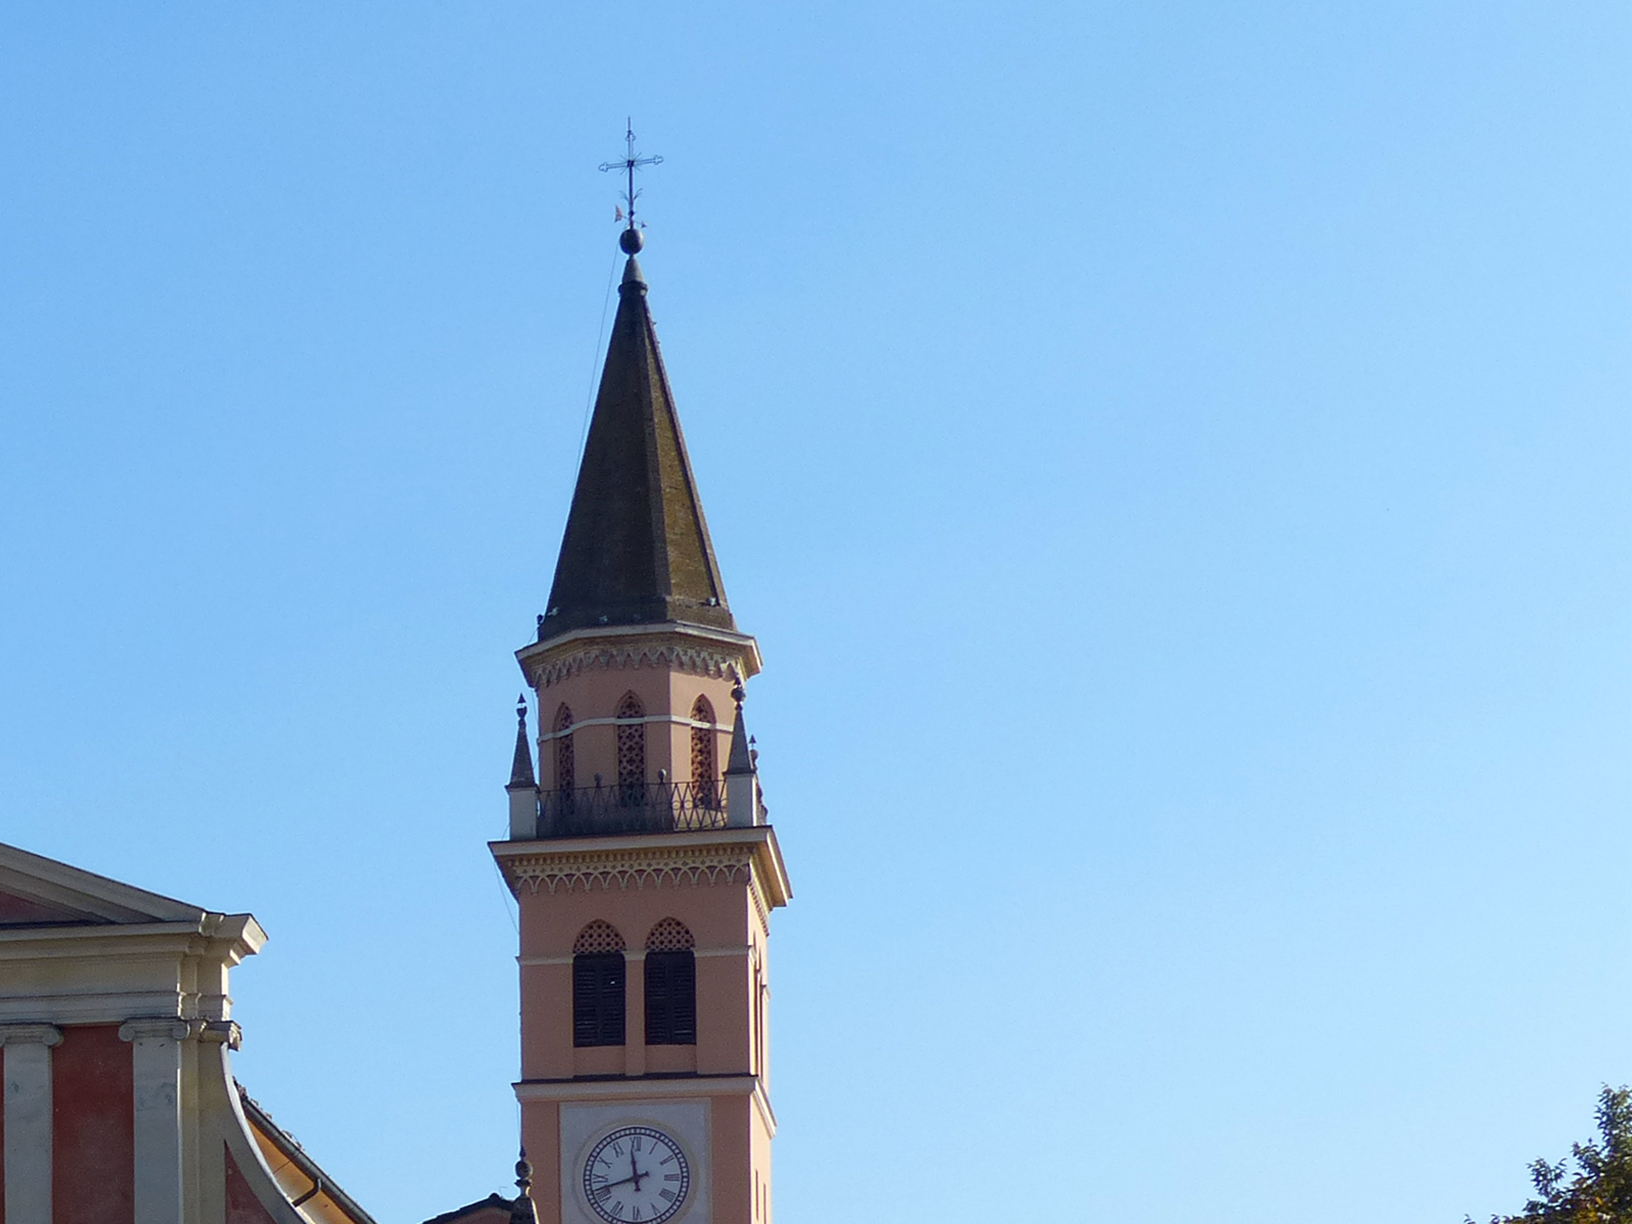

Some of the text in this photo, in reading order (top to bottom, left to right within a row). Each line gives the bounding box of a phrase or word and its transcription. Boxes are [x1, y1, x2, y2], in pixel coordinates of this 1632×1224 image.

[610, 1141, 624, 1158] XI
[649, 1141, 658, 1155] I
[597, 1156, 613, 1169] X
[659, 1154, 674, 1166] II
[664, 1173, 679, 1182] III
[651, 1202, 661, 1216] V
